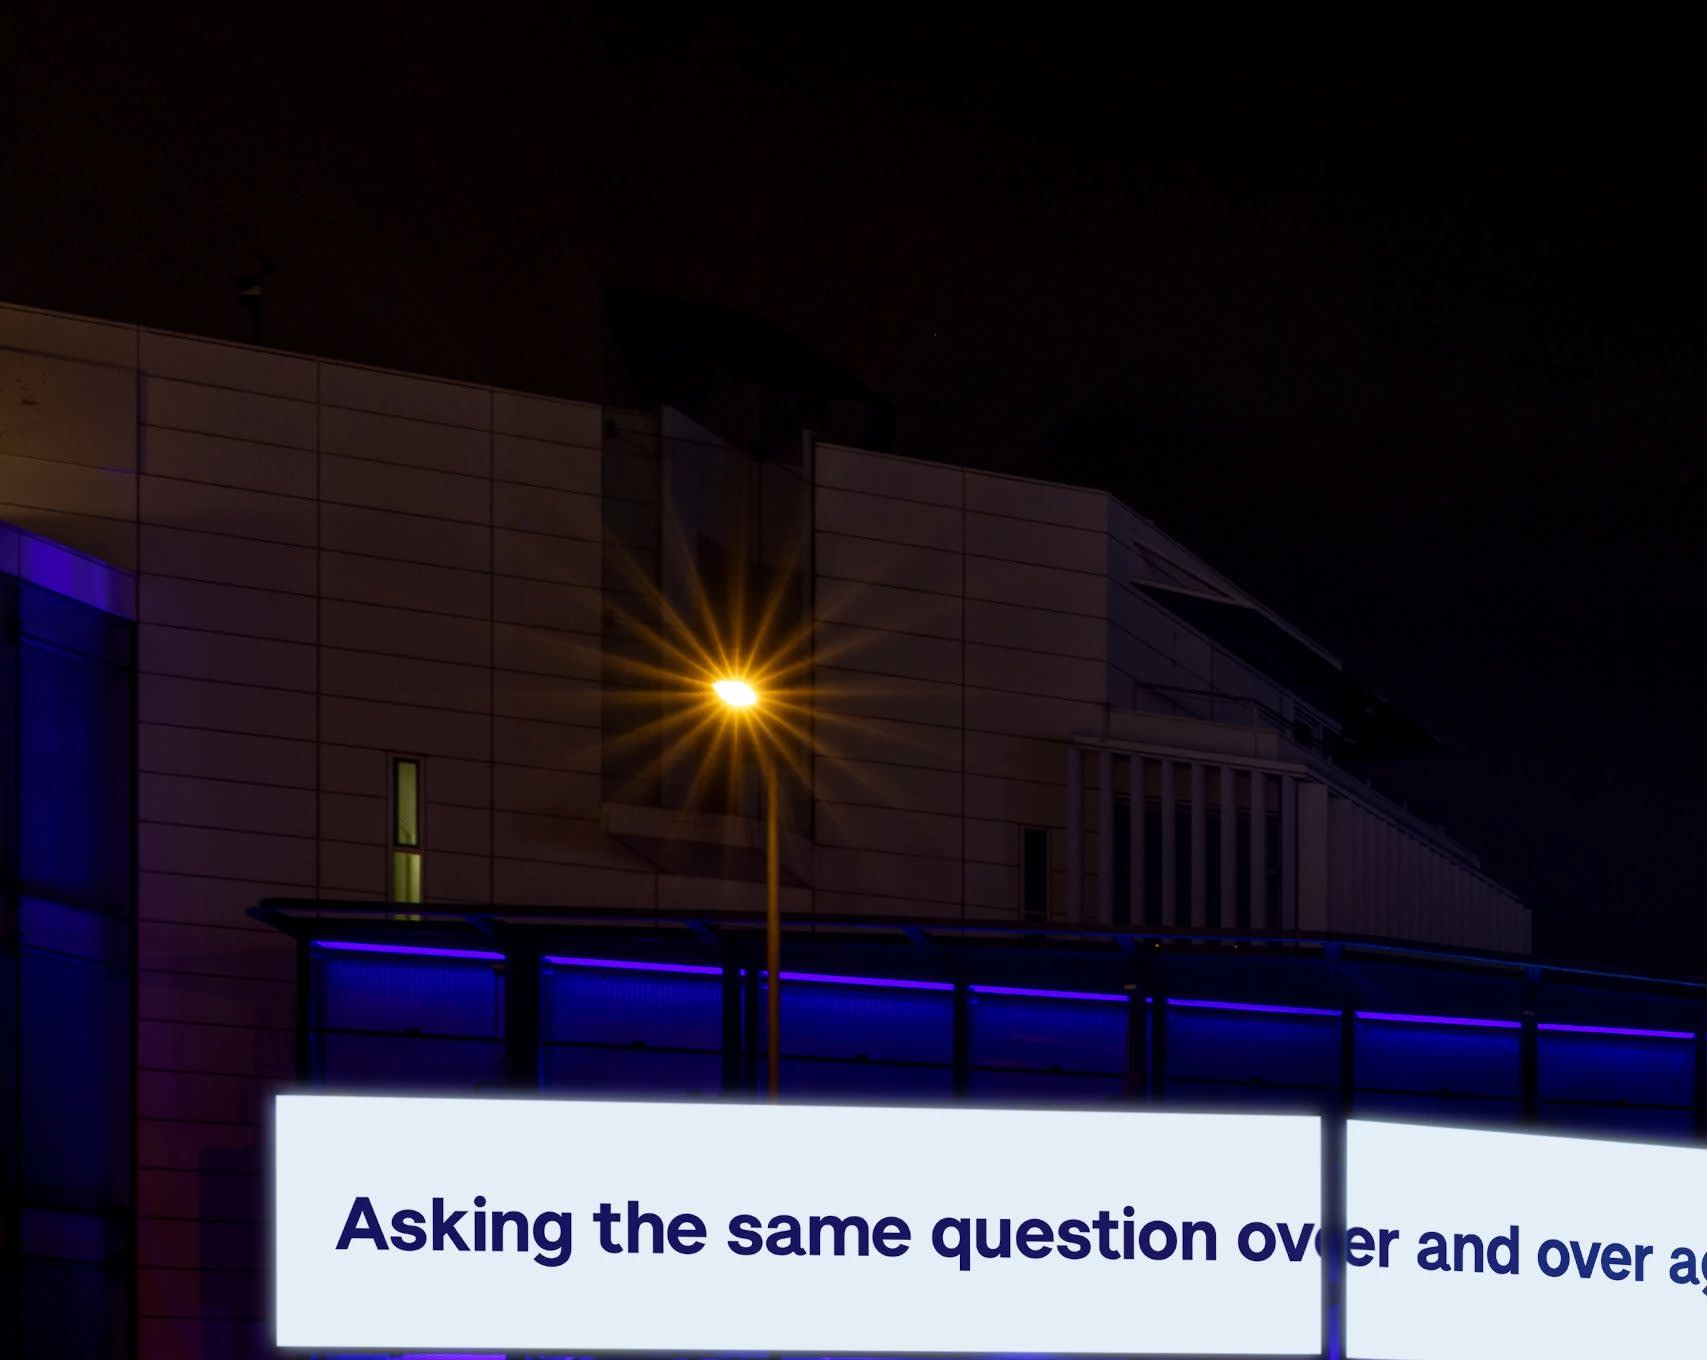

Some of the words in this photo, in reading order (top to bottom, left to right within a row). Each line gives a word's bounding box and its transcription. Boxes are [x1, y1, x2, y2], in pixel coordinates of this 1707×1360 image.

[335, 1195, 572, 1267] Asking
[593, 1200, 707, 1255] the
[728, 1214, 911, 1257] same
[932, 1206, 1216, 1271] question
[1417, 1225, 1519, 1275] and
[1537, 1239, 1653, 1282] over
